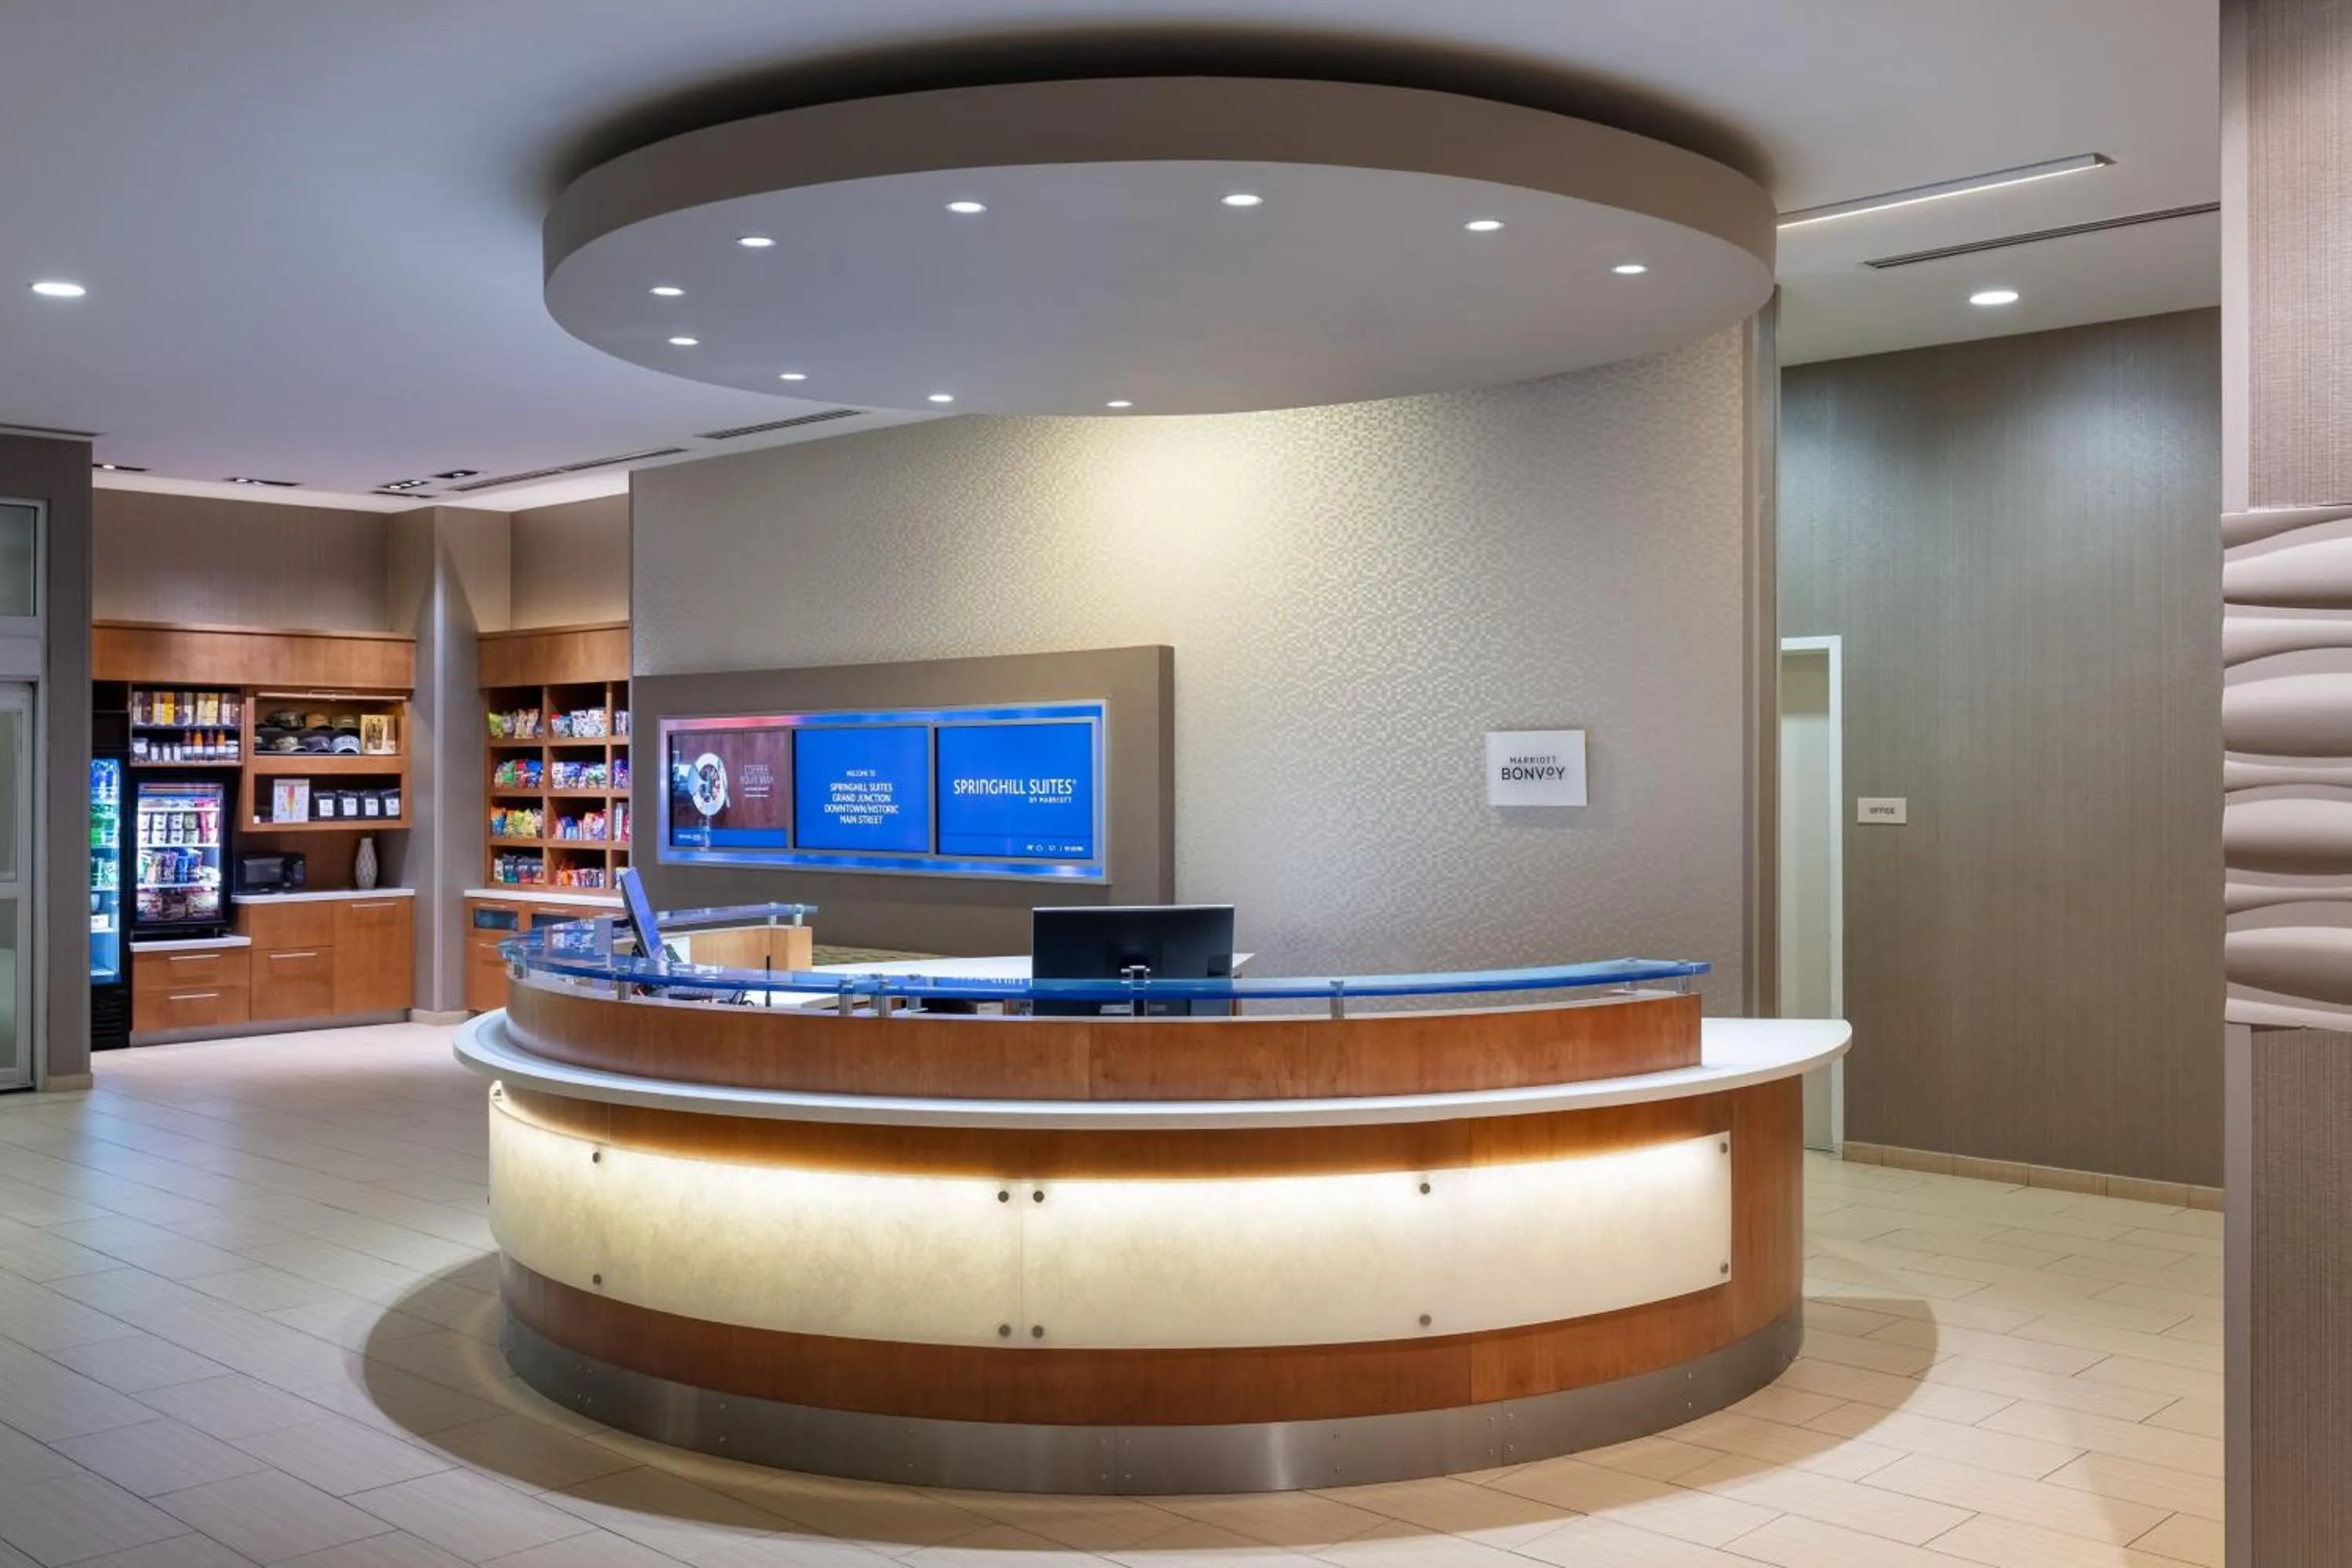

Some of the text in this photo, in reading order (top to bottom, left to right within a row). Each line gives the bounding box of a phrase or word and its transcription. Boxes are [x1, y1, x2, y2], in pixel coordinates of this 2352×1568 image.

[1508, 755, 1556, 764] MARRIOTT
[1501, 766, 1566, 781] BONVOY
[830, 782, 893, 793] SPRINGHILL SUITES
[953, 779, 1026, 795] SPRINGHILL
[832, 793, 891, 803] GRAND JUNCTION
[840, 815, 883, 826] MAIN STREET
